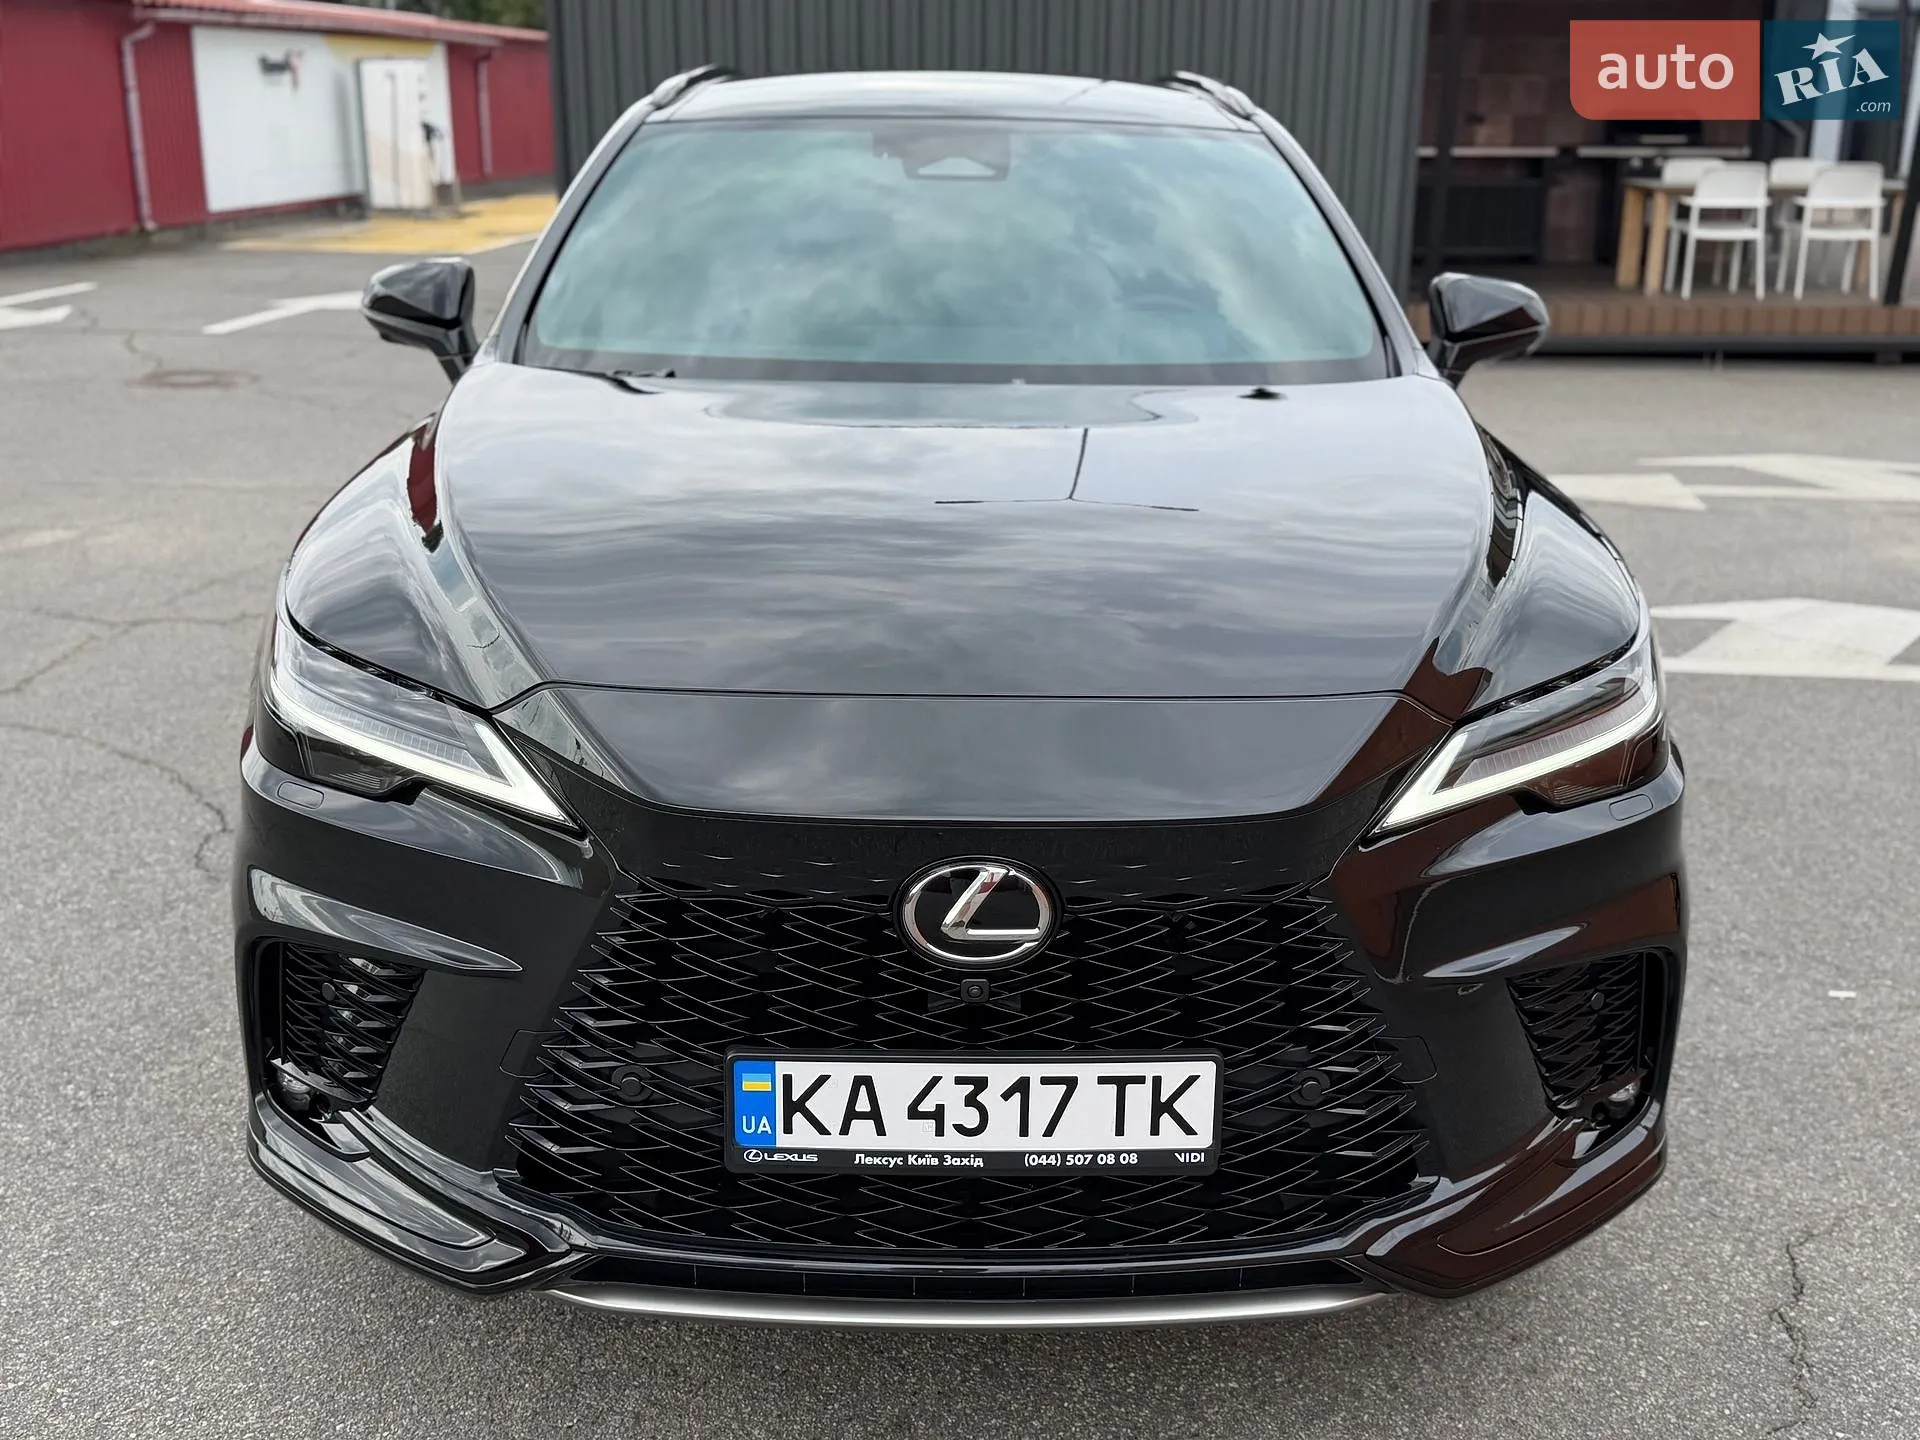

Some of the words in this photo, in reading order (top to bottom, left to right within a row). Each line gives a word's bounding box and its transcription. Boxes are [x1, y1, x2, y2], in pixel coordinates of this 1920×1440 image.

[906, 1075, 1078, 1138] 4317
[742, 1116, 772, 1135] UA
[763, 1153, 819, 1163] LEXUS
[853, 1154, 904, 1167] Лексус
[907, 1153, 939, 1166] Київ
[942, 1153, 984, 1168] Захід
[1024, 1153, 1062, 1168] (044)
[1066, 1153, 1094, 1165] 507
[1097, 1153, 1117, 1166] 08
[1120, 1153, 1138, 1166] 08
[1174, 1152, 1205, 1163] VIDI
